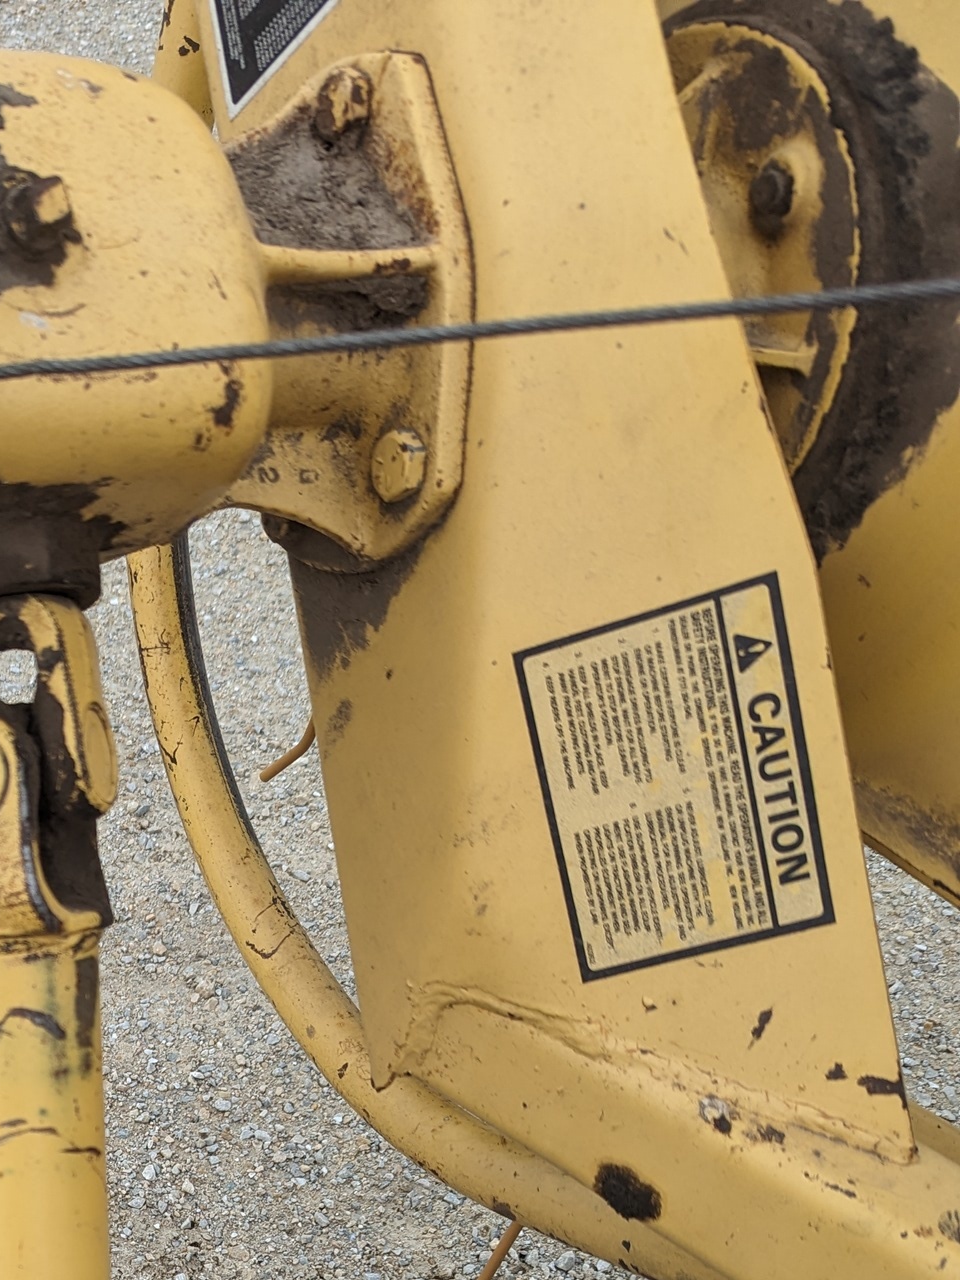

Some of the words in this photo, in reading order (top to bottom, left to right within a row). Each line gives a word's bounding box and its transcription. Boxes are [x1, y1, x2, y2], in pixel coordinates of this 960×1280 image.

[690, 610, 704, 646] SAFETY
[701, 607, 716, 642] BEFORE
[708, 643, 726, 694] OPERATING
[717, 693, 729, 714] THIS
[729, 759, 742, 783] READ
[734, 783, 745, 801] THE
[745, 688, 811, 887] CAUTION
[746, 854, 761, 889] MANUAL
[753, 890, 765, 908] AND
[757, 909, 768, 925] ALL
